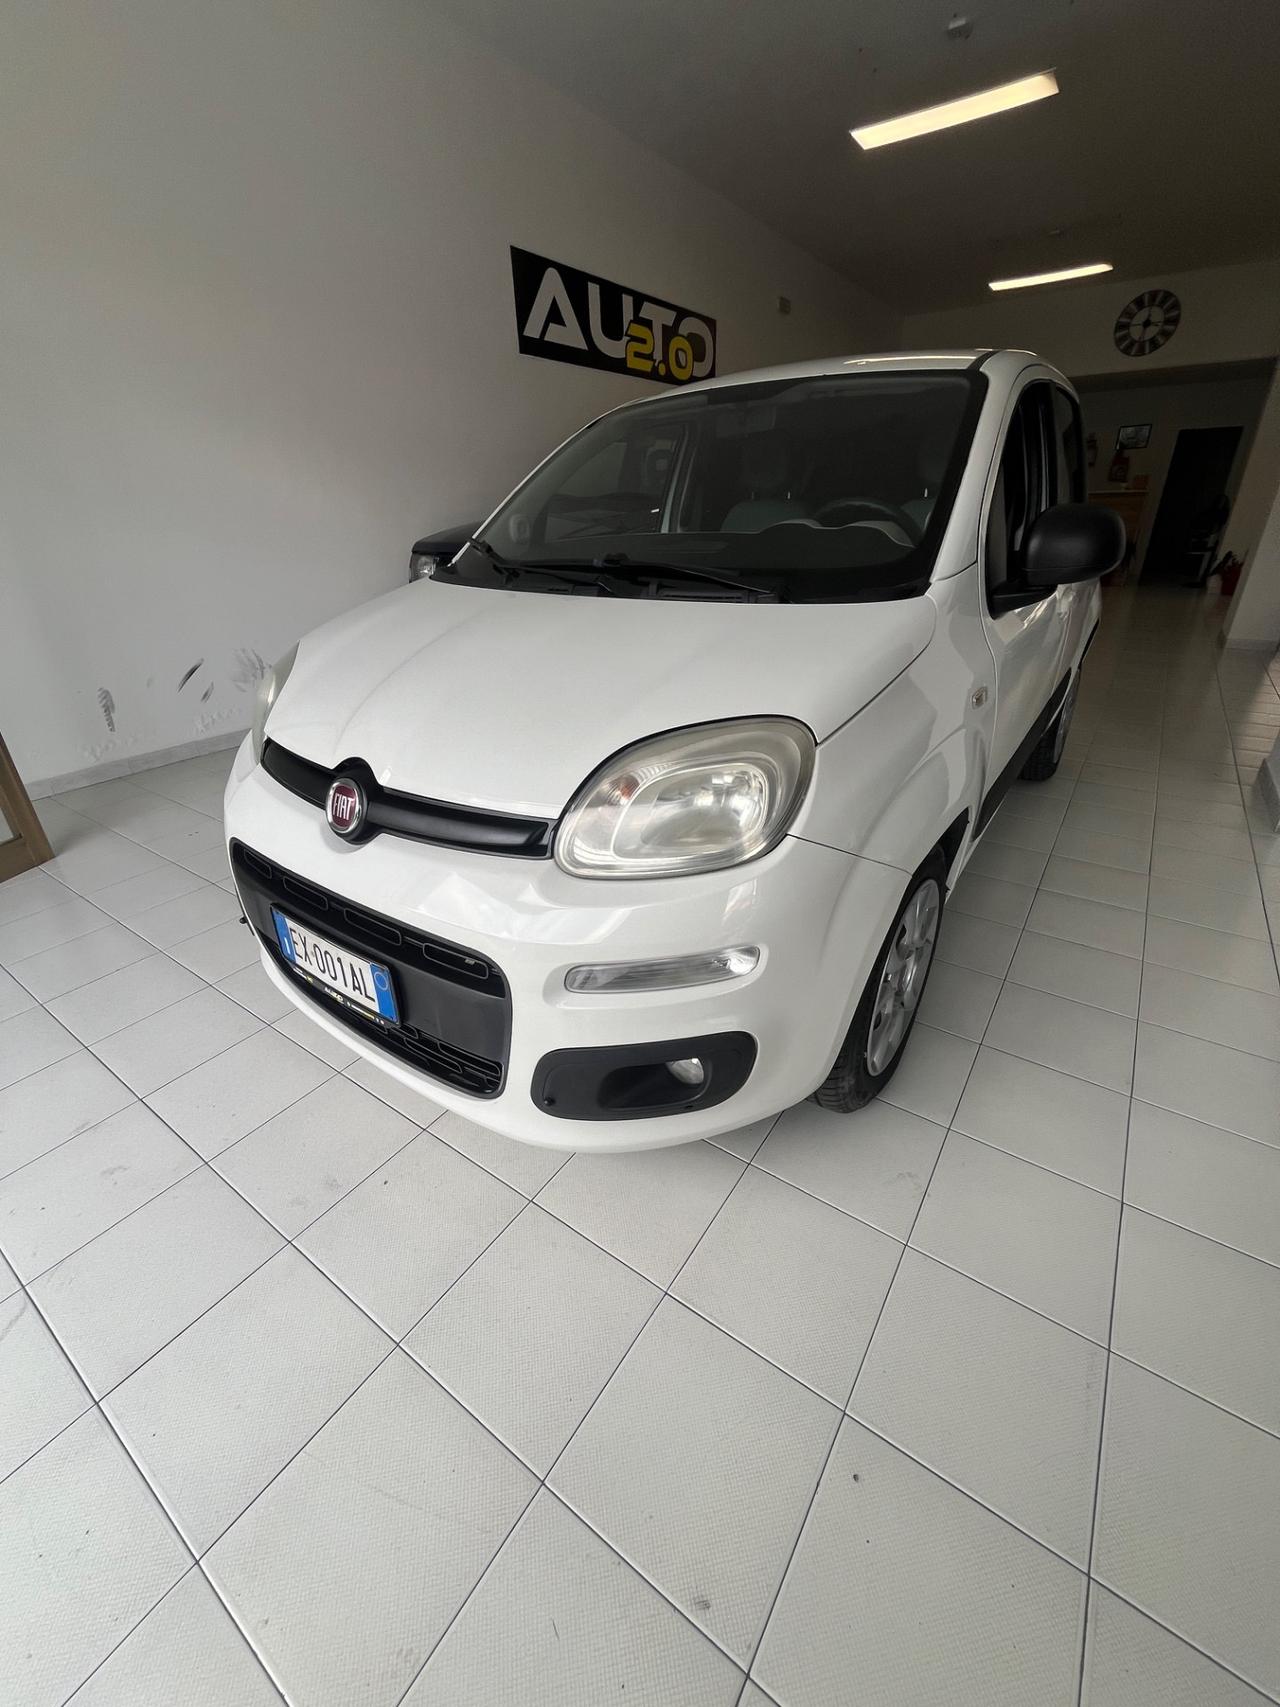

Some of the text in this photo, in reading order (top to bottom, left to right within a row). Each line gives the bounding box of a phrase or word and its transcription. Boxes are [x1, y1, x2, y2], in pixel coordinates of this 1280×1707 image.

[523, 267, 714, 378] AUTO
[625, 322, 694, 381] 2.0
[333, 792, 355, 820] FIAT
